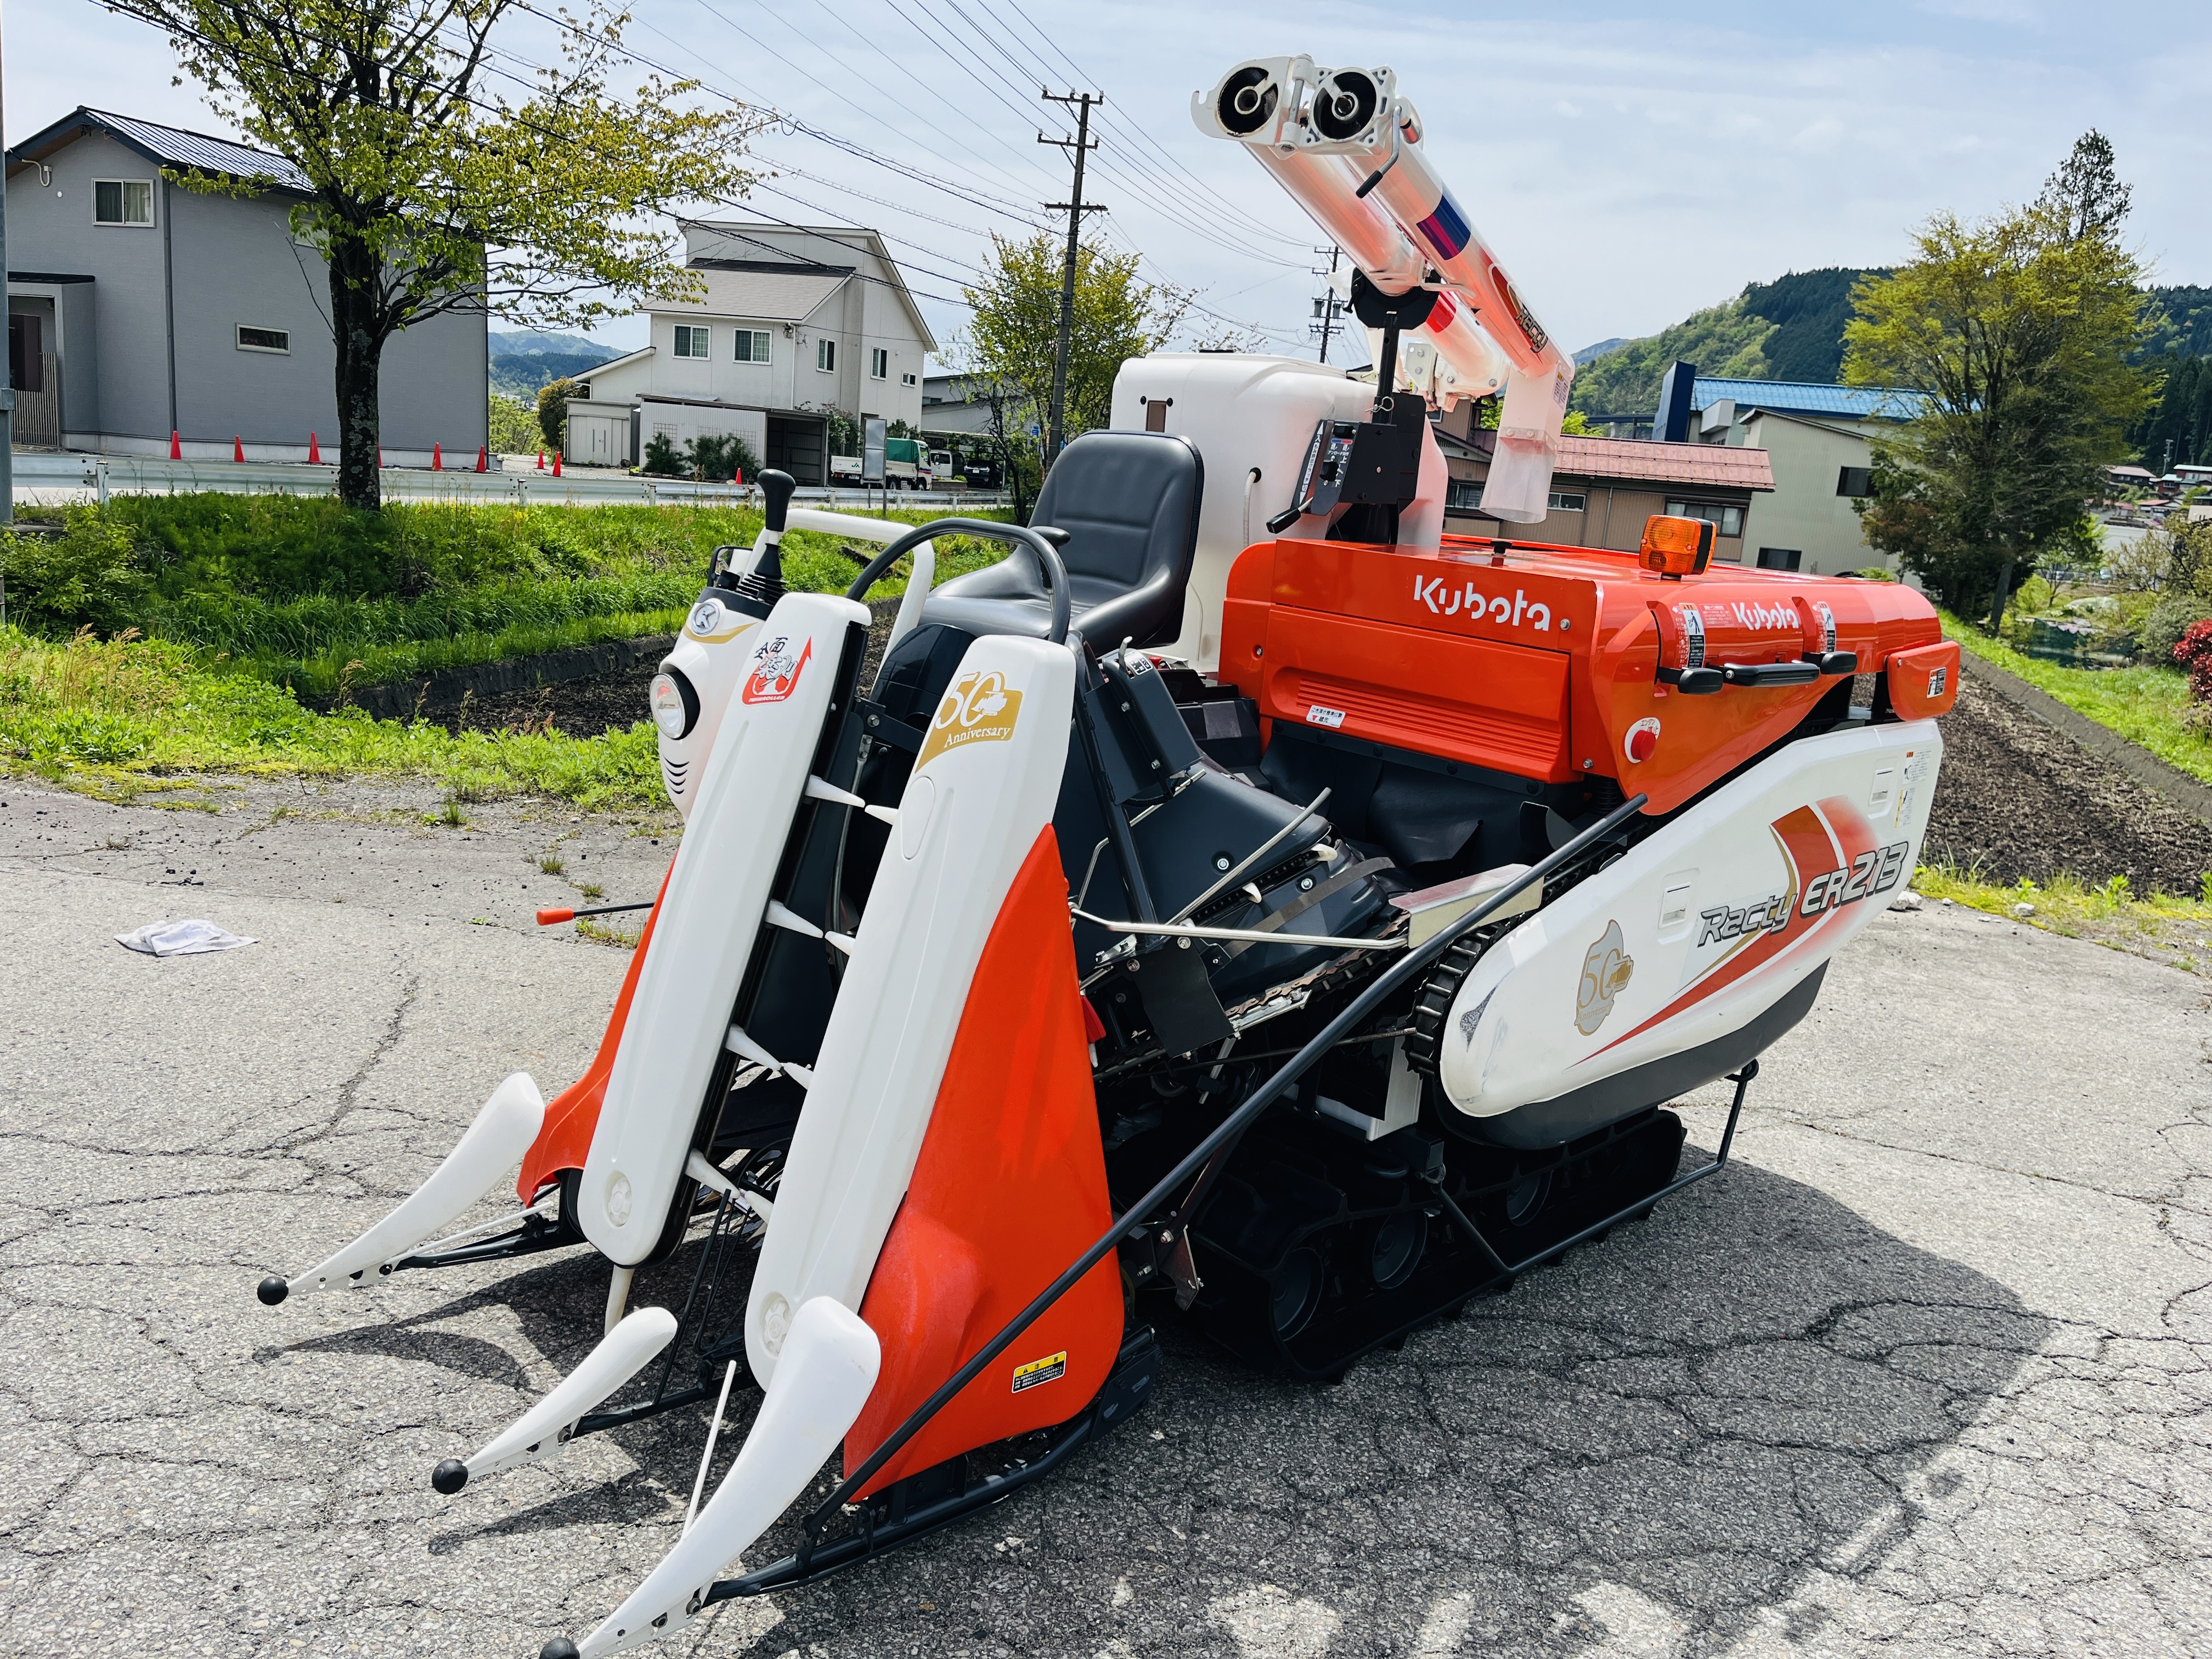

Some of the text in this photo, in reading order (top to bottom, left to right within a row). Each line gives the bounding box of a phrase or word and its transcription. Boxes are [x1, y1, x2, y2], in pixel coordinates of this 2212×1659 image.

[1514, 303, 1548, 353] Racty
[1413, 575, 1550, 631] Kubota
[1731, 602, 1799, 630] Kubota
[935, 672, 1002, 730] 50
[944, 727, 1011, 748] Anniversary
[1697, 841, 1909, 947] Racty ER213
[1578, 948, 1621, 1009] 50
[1578, 1003, 1612, 1022] Anniversary
